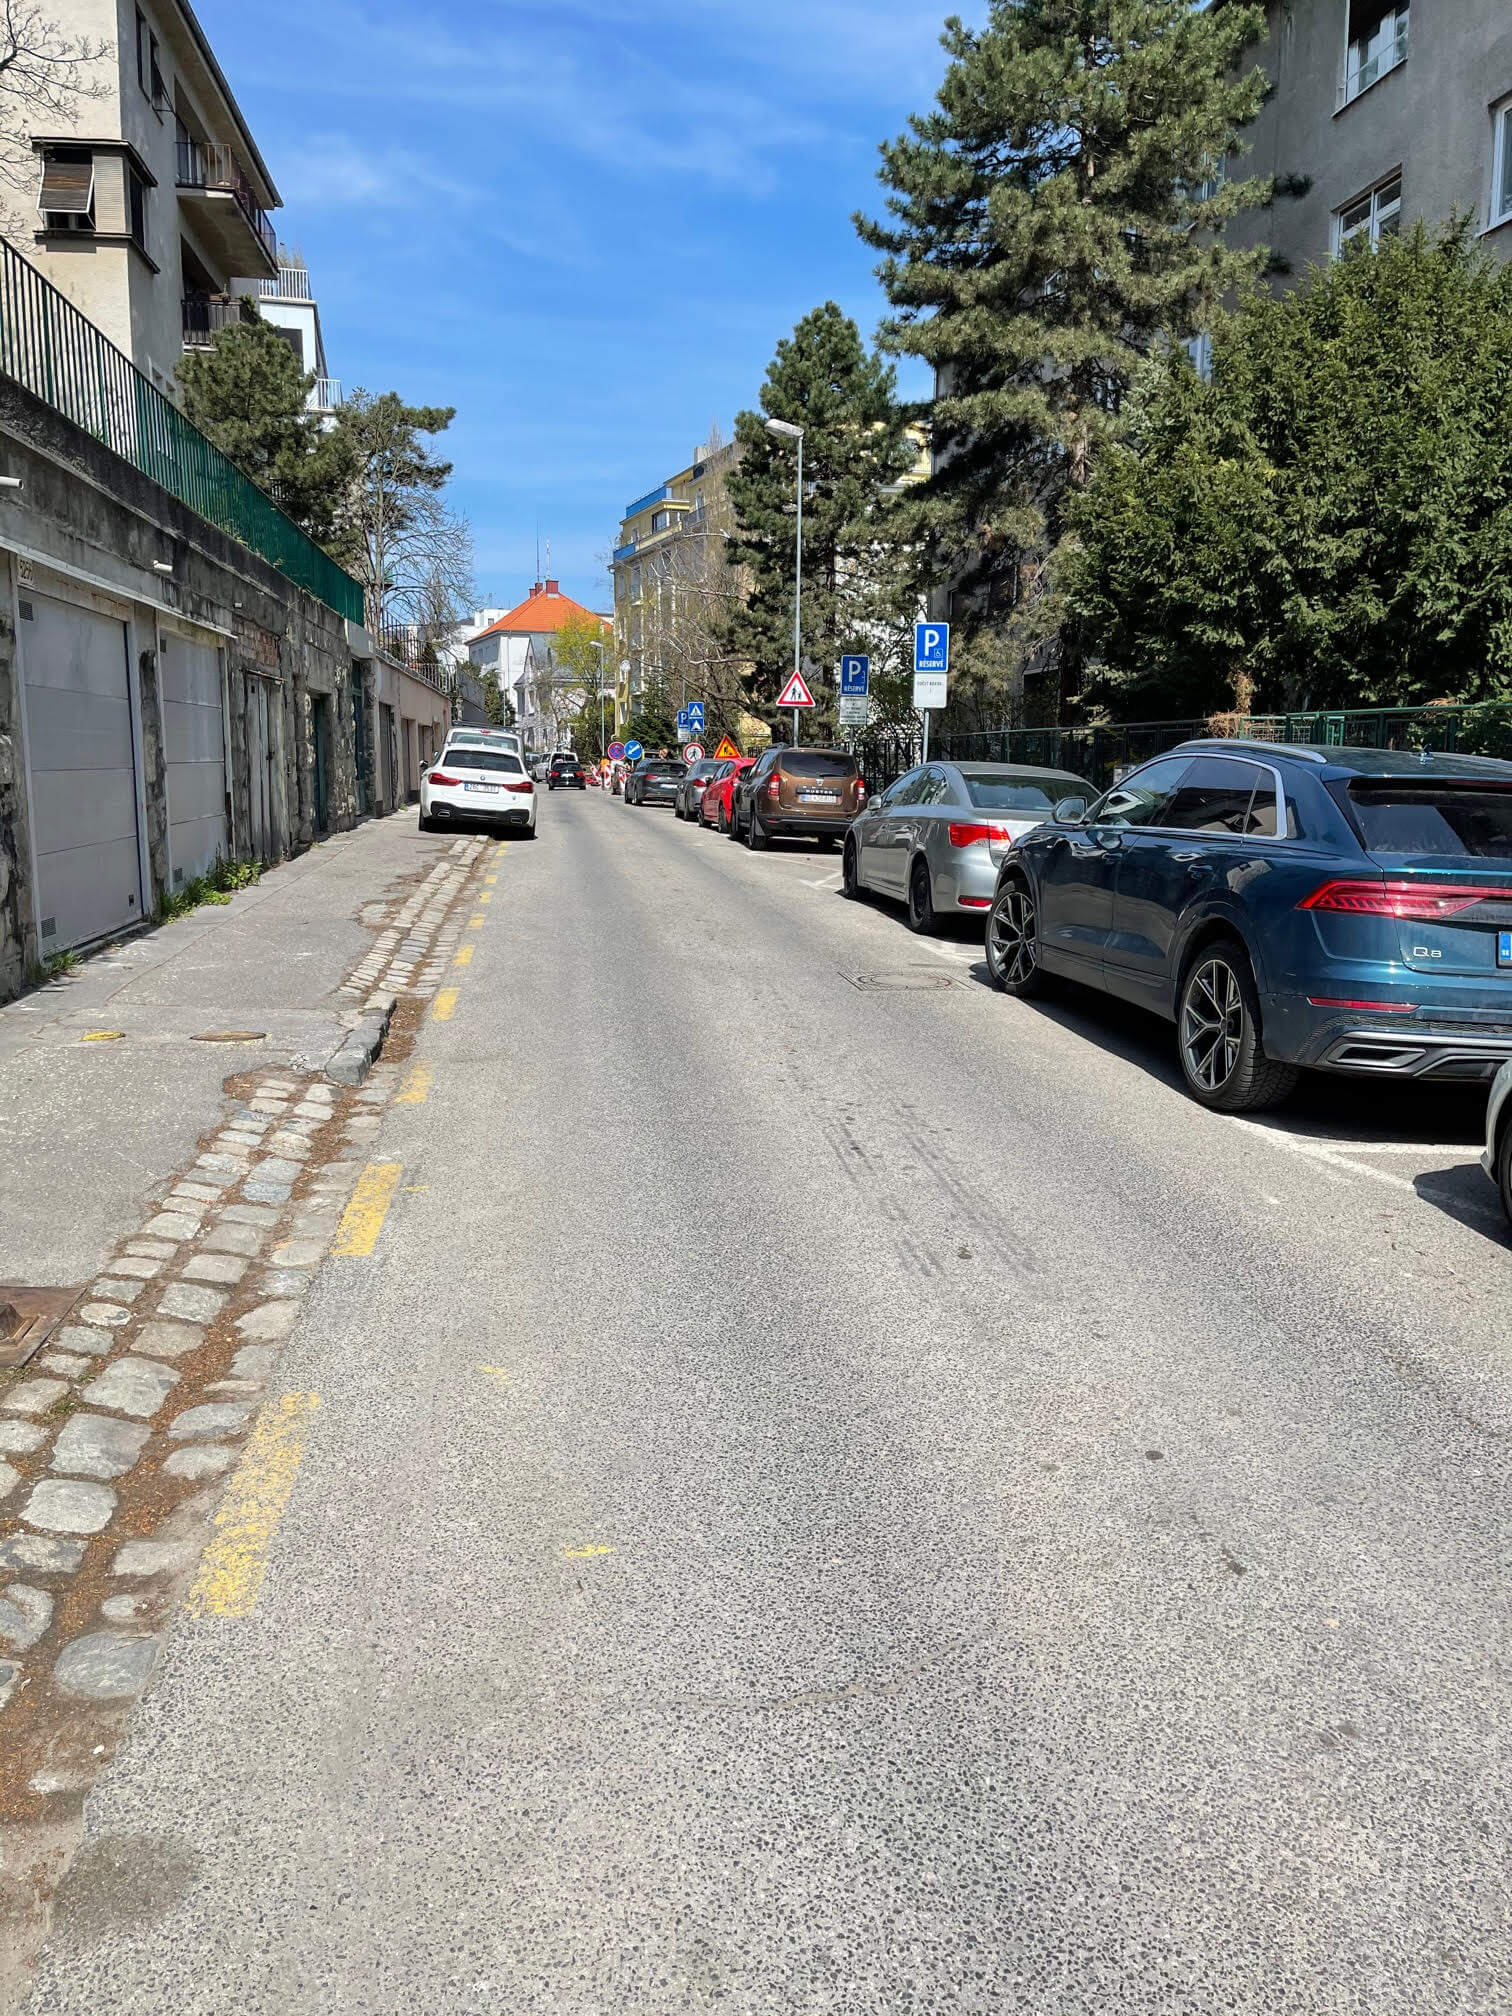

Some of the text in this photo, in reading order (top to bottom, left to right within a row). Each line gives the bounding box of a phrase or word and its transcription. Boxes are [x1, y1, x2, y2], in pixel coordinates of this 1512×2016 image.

[925, 629, 940, 656] P
[849, 660, 861, 682] P
[1413, 946, 1442, 958] Q8
